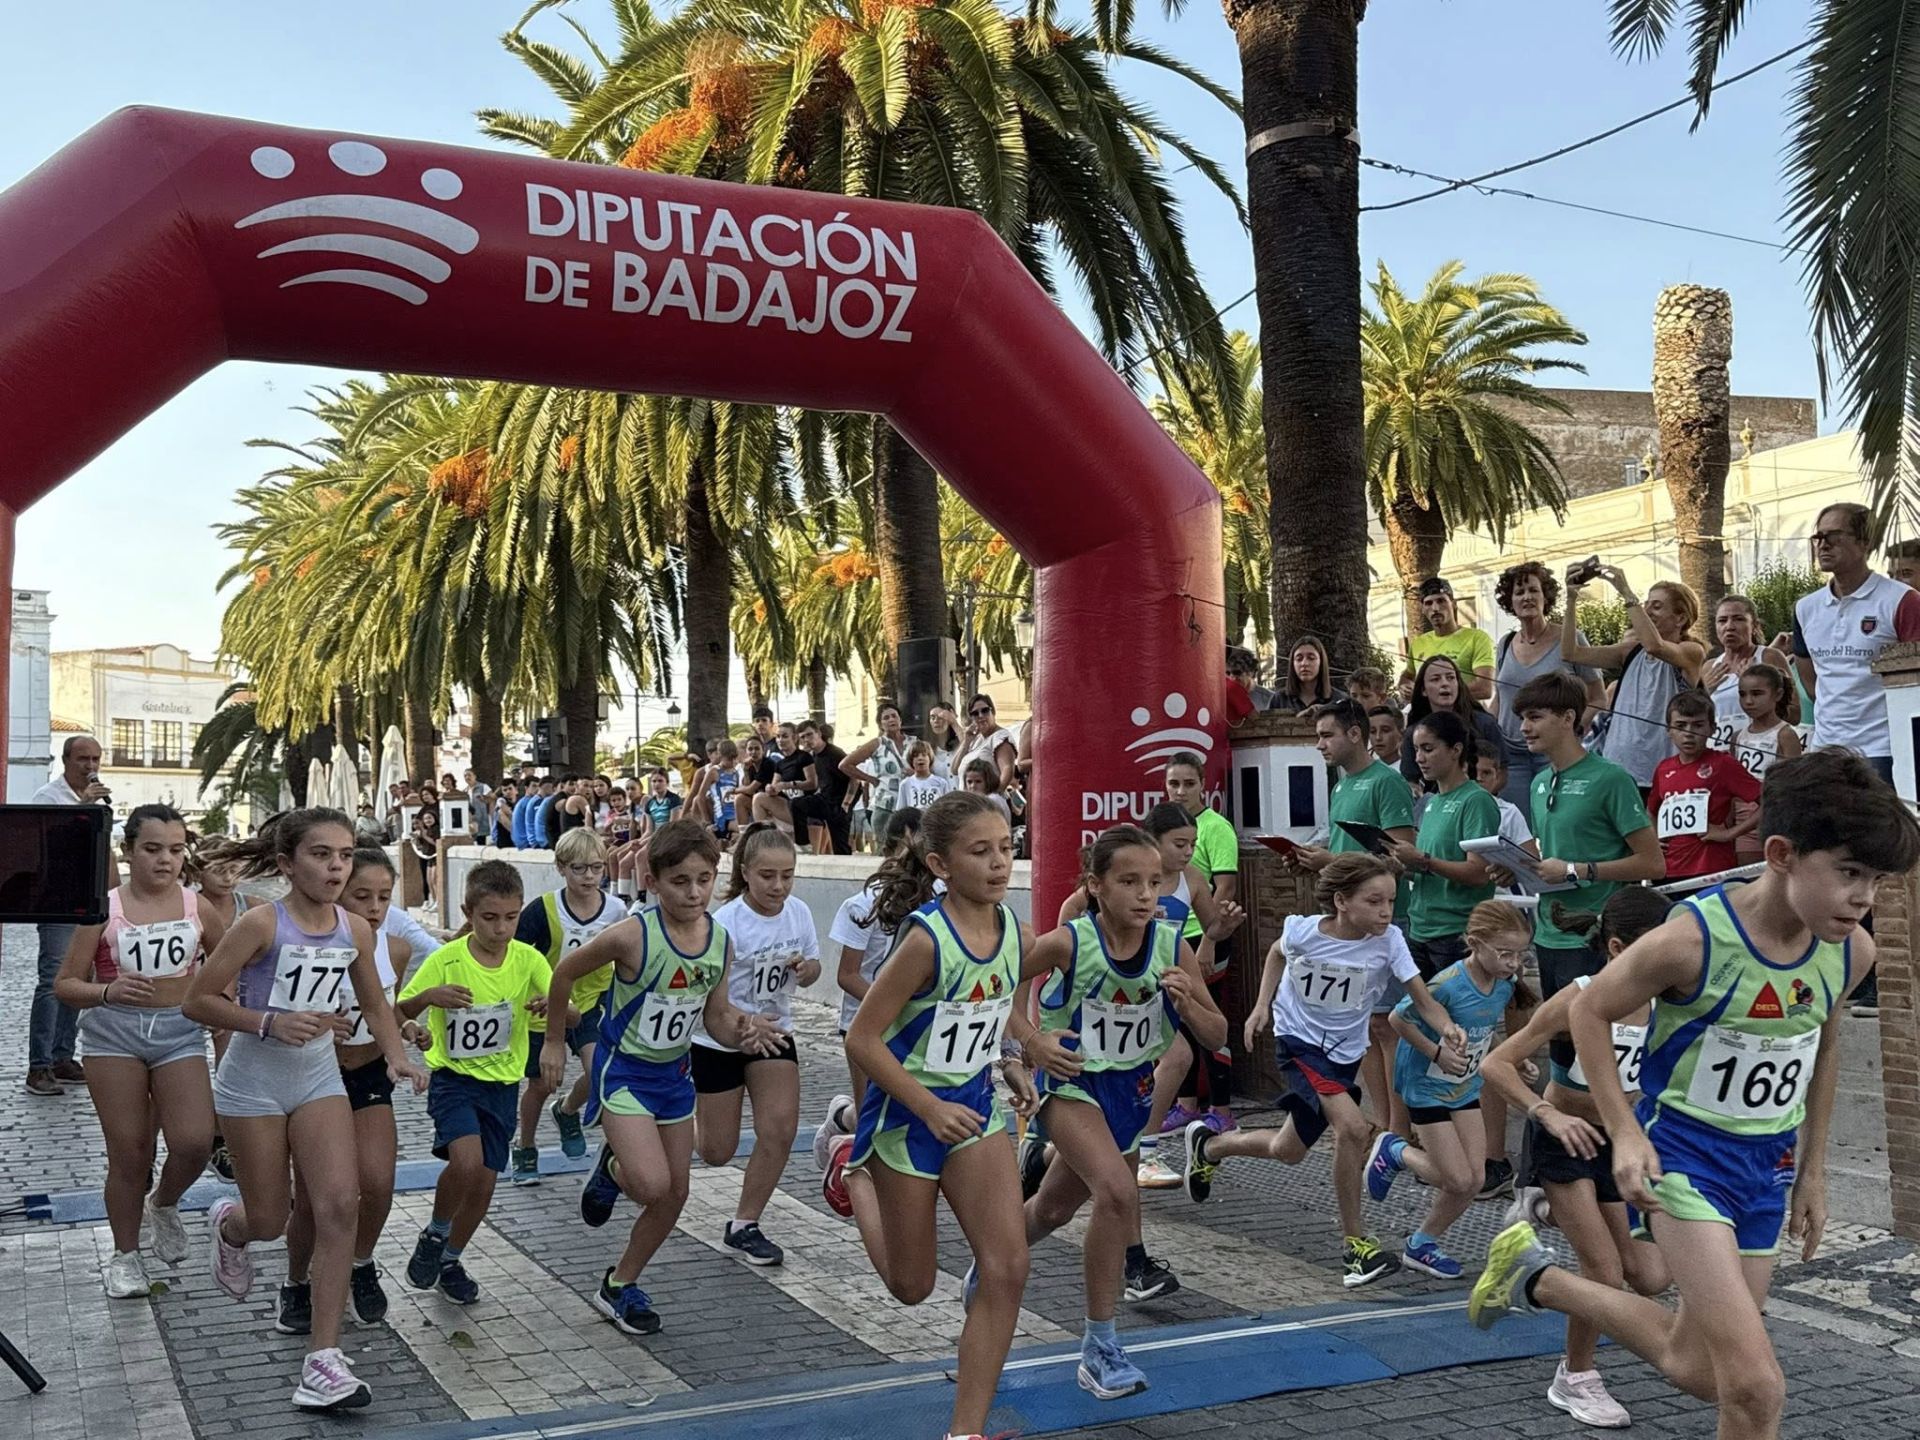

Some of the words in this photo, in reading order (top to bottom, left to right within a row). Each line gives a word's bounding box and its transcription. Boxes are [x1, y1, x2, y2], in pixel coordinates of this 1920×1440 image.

[525, 183, 917, 281] DIPUTACIÓN
[525, 256, 590, 308] DE
[612, 251, 917, 343] BADAJOZ
[1831, 645, 1844, 656] del
[1845, 645, 1873, 656] Hierro
[1662, 804, 1696, 832] 163
[128, 936, 185, 972] 176
[285, 965, 346, 1003] 177
[1300, 972, 1351, 1002] 171
[446, 1018, 499, 1051] 182
[649, 1006, 702, 1042] 167
[940, 1016, 999, 1064] 174
[1092, 1016, 1150, 1055] 170
[1712, 1056, 1802, 1108] 168
